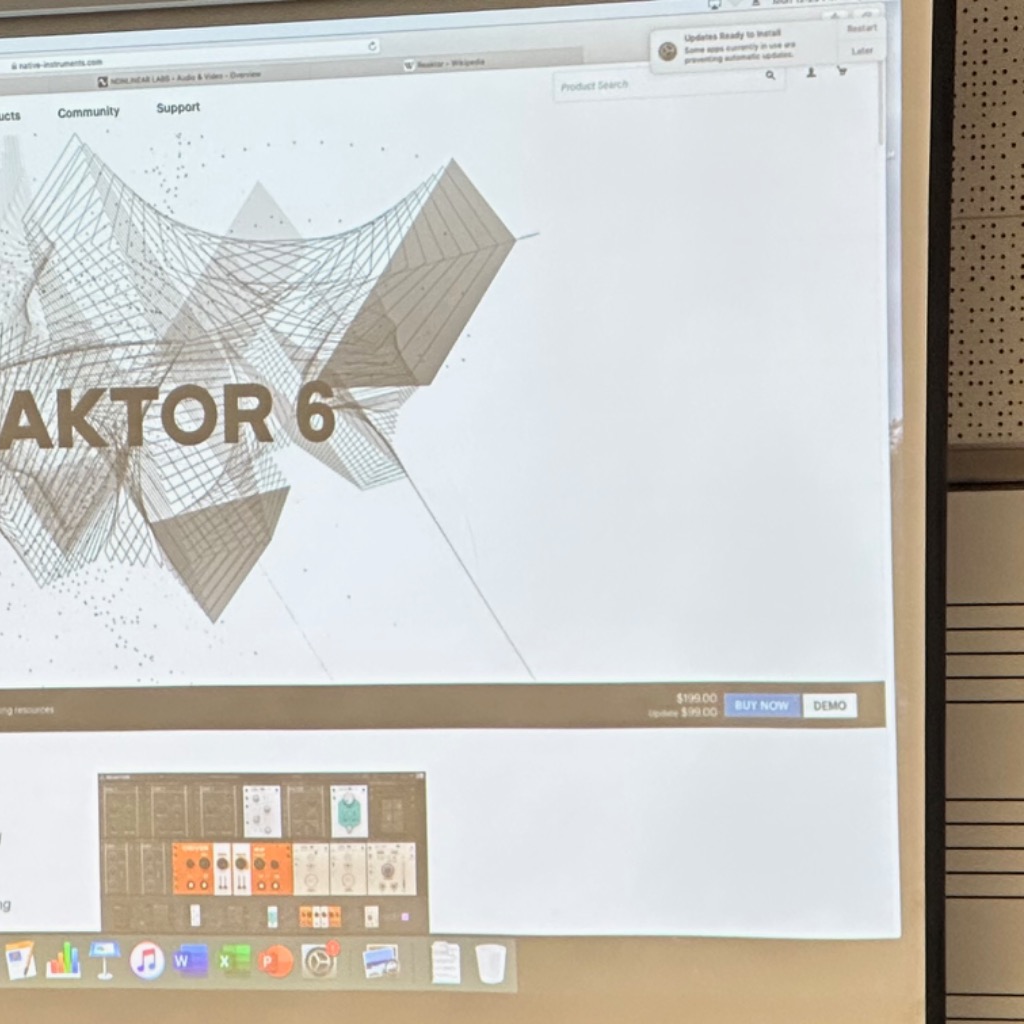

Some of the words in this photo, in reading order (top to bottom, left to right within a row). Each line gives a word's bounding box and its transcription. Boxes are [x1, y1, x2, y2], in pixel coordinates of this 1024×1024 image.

[847, 23, 878, 33] Restart
[684, 33, 718, 43] Updates
[719, 31, 744, 41] Ready
[746, 30, 756, 39] to
[756, 28, 782, 37] Install
[851, 46, 874, 56] Later
[18, 58, 103, 71] native-instruments.com
[560, 81, 596, 92] Product
[597, 79, 629, 90] Search
[57, 105, 121, 120] Community
[156, 102, 201, 115] Support
[296, 380, 337, 444] 6
[676, 692, 718, 705] $199.00
[734, 700, 759, 712] BUY
[760, 699, 790, 712] NOW
[813, 700, 848, 712] DEMO
[14, 706, 55, 716] resources
[681, 706, 719, 719] $99.00
